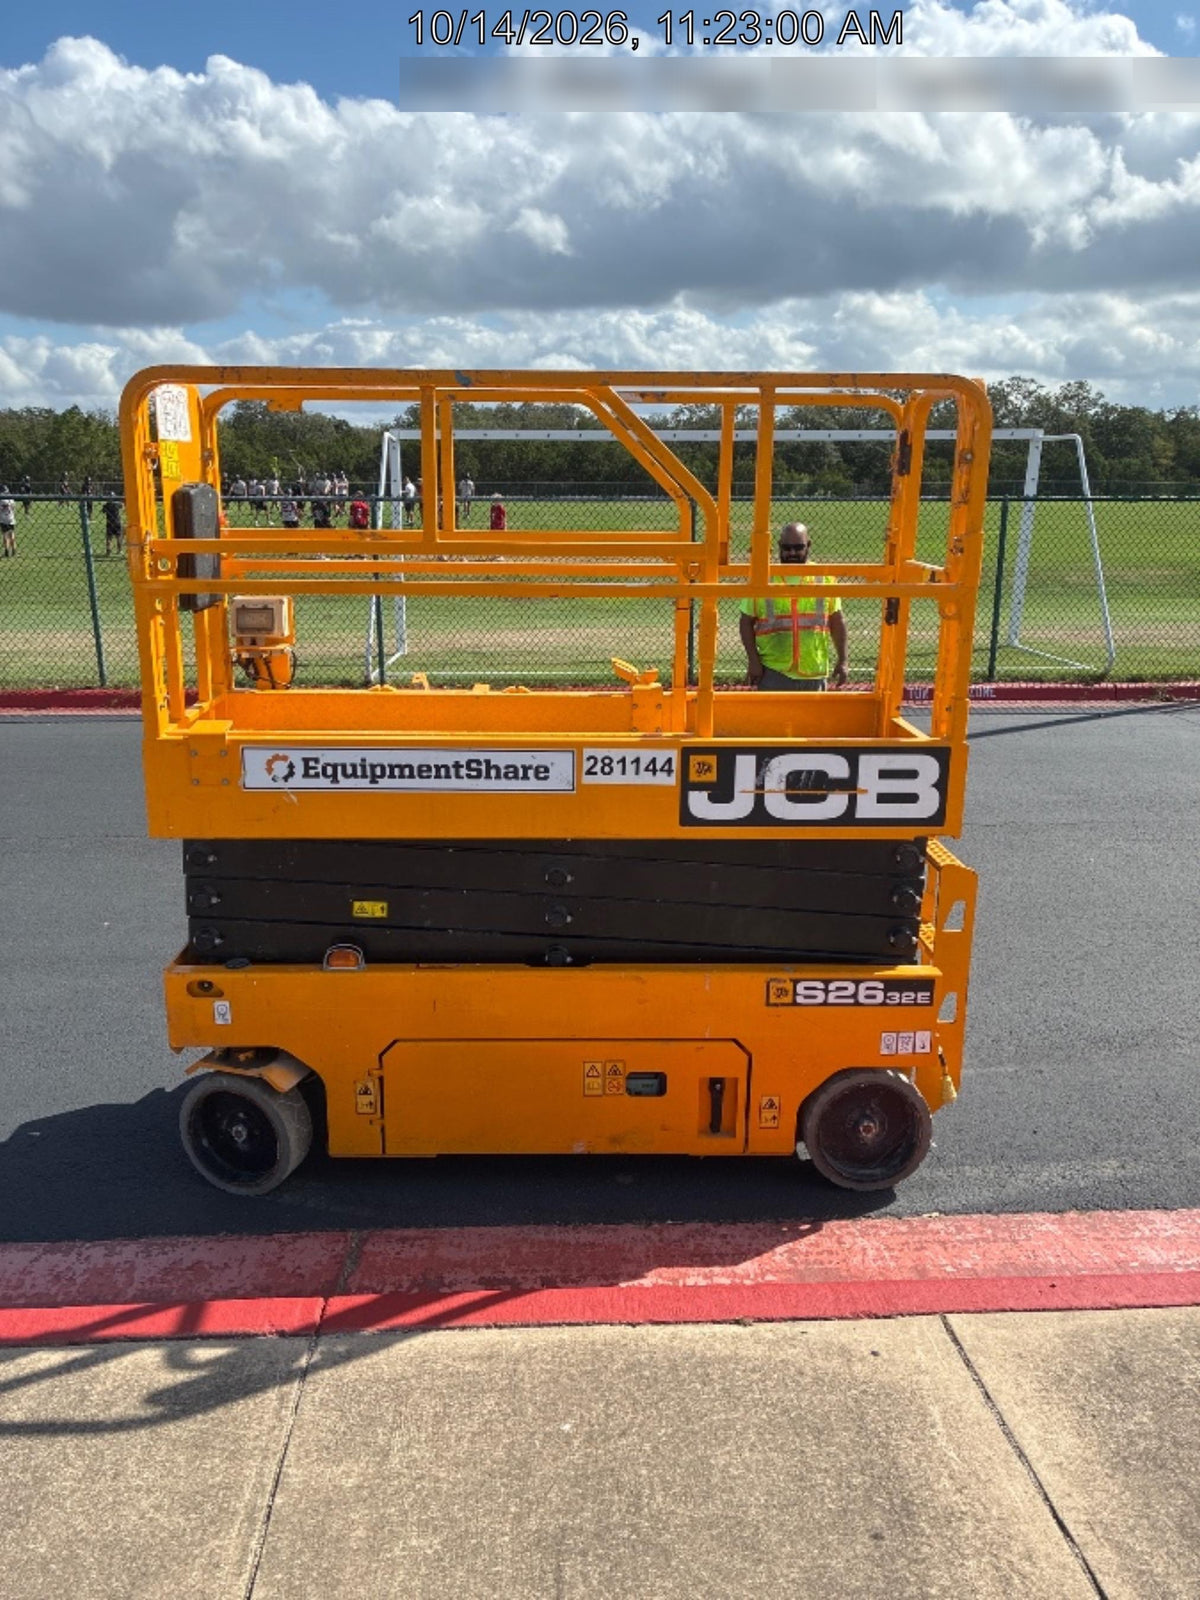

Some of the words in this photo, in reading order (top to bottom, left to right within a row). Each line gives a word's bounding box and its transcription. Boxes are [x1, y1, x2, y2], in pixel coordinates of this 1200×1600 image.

[301, 757, 551, 784] EquipmentShare
[584, 755, 675, 777] 281144
[687, 753, 940, 820] JCB
